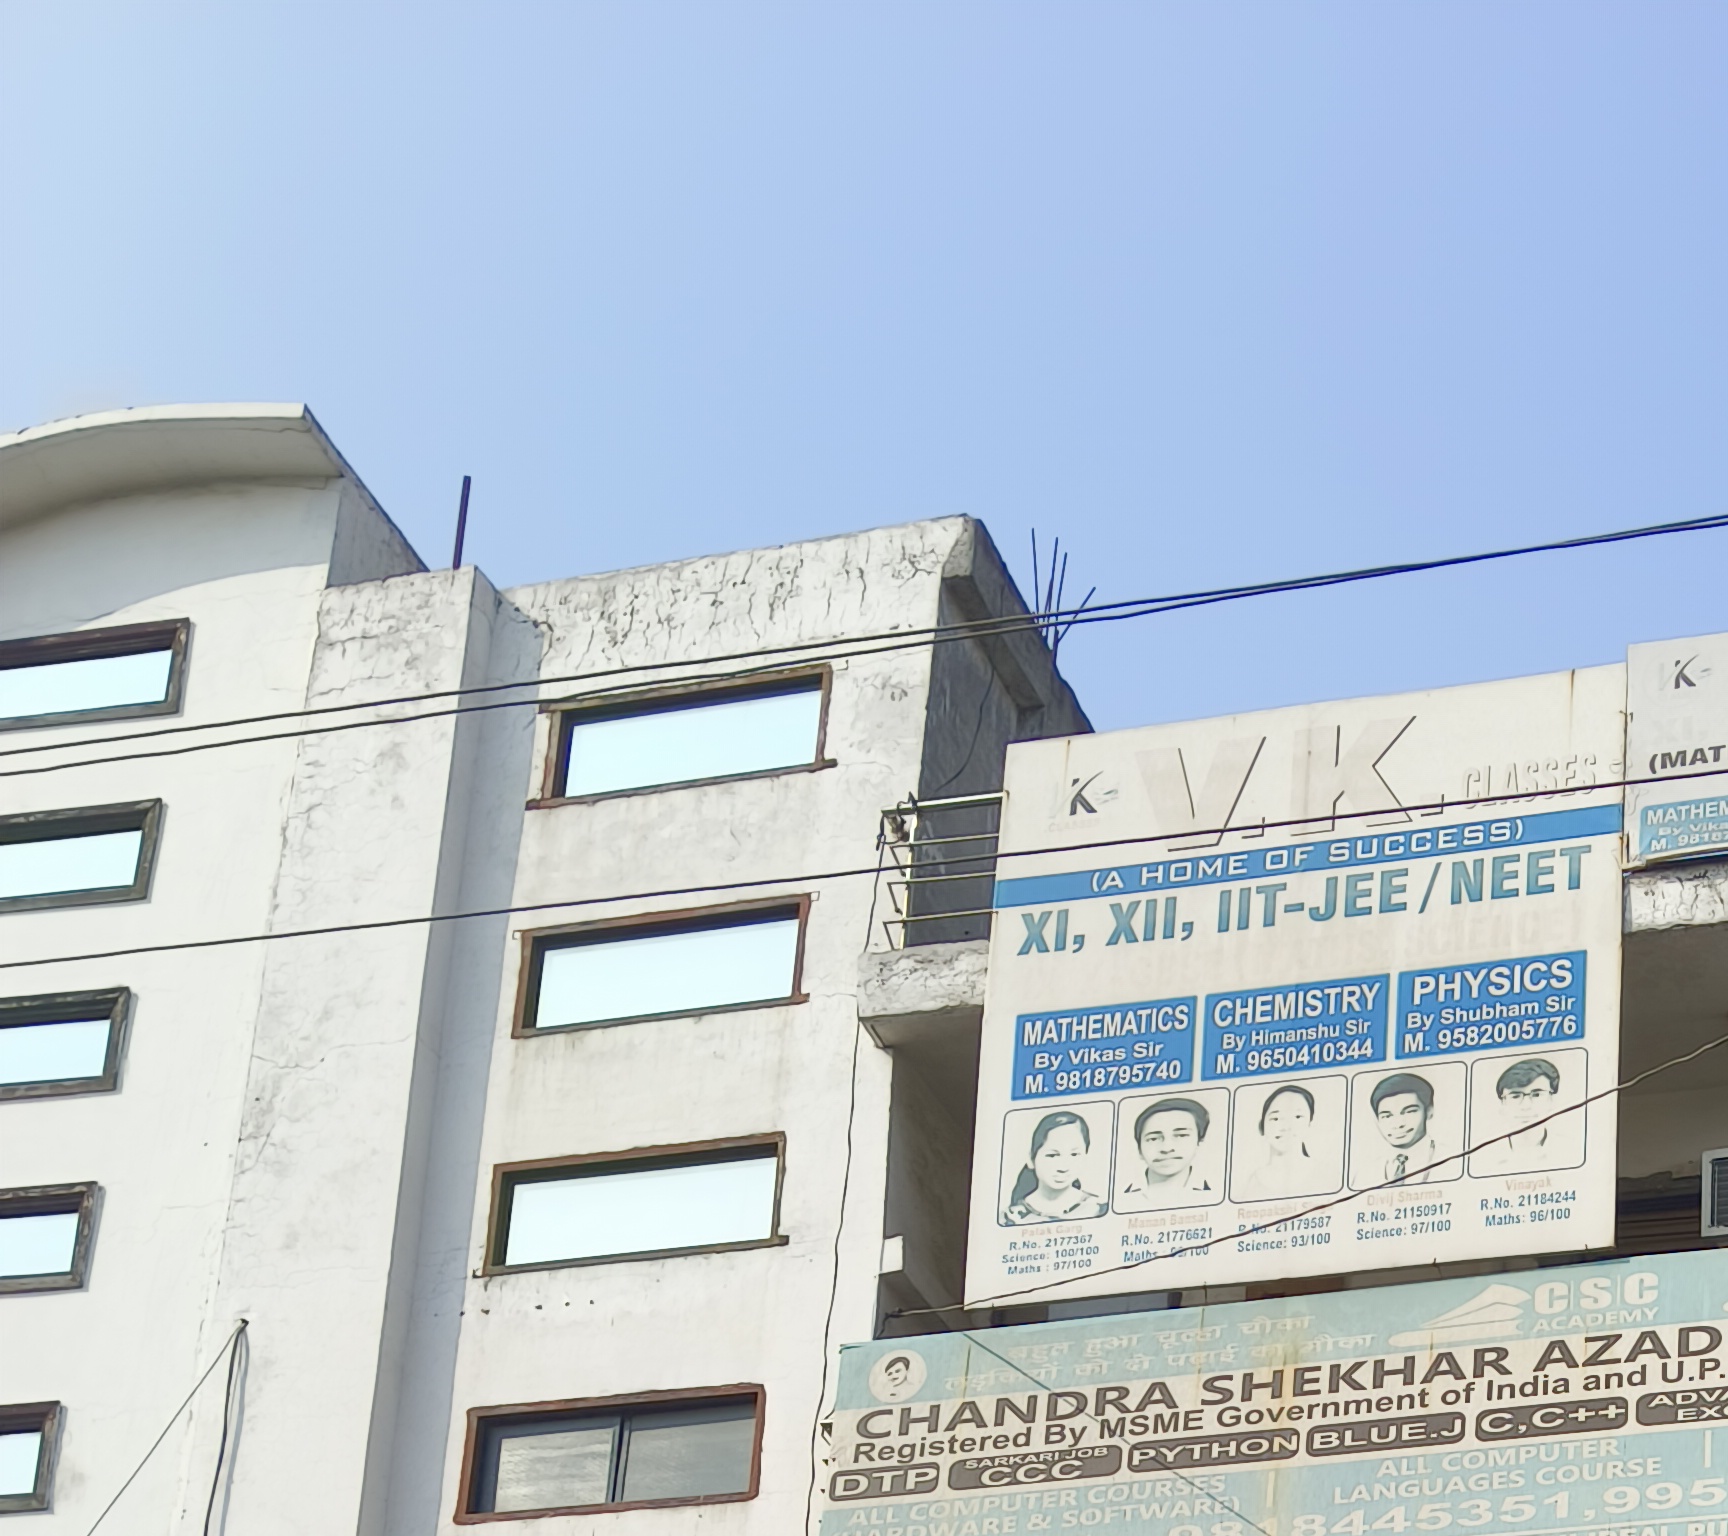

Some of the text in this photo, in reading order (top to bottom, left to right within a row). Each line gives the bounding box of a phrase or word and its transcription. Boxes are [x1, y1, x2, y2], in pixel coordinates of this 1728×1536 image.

[1092, 818, 1524, 893] (A HOME OF SUCCESS)
[1017, 908, 1086, 957] XI,
[1105, 896, 1194, 947] XII,
[1412, 958, 1574, 1007] PHYSICS
[1213, 981, 1382, 1028] CHEMISTRY
[1406, 994, 1577, 1031] By Shubham Sir
[1023, 1004, 1190, 1047] MATHEMATICS
[1222, 1017, 1371, 1053] By Himanshu Sir
[1404, 1014, 1577, 1054] M. 9582005776
[1034, 1041, 1164, 1072] By Vikas Sir
[1215, 1037, 1374, 1075] M. 9650410344
[1024, 1059, 1183, 1095] M. 9818795740
[1518, 1190, 1577, 1208] 21184244
[1531, 1307, 1660, 1333] ACADEMY
[856, 1381, 1178, 1440] CHANDRA
[1200, 1345, 1513, 1406] SHEKHAR
[1533, 1325, 1723, 1373] AZAD
[853, 1425, 1033, 1464] Registered
[1045, 1423, 1088, 1448] By
[1099, 1408, 1204, 1440] MSME
[1217, 1386, 1430, 1428] Government
[1441, 1382, 1476, 1406] of
[1486, 1373, 1578, 1402] India
[1582, 1364, 1648, 1392] and
[1661, 1358, 1727, 1383] U.P.
[1480, 1404, 1626, 1434] C,C++
[1132, 1433, 1299, 1466] PYTHON
[1312, 1419, 1462, 1450] BLUE.J
[834, 1468, 938, 1497] DTP
[979, 1459, 1085, 1487] CCC
